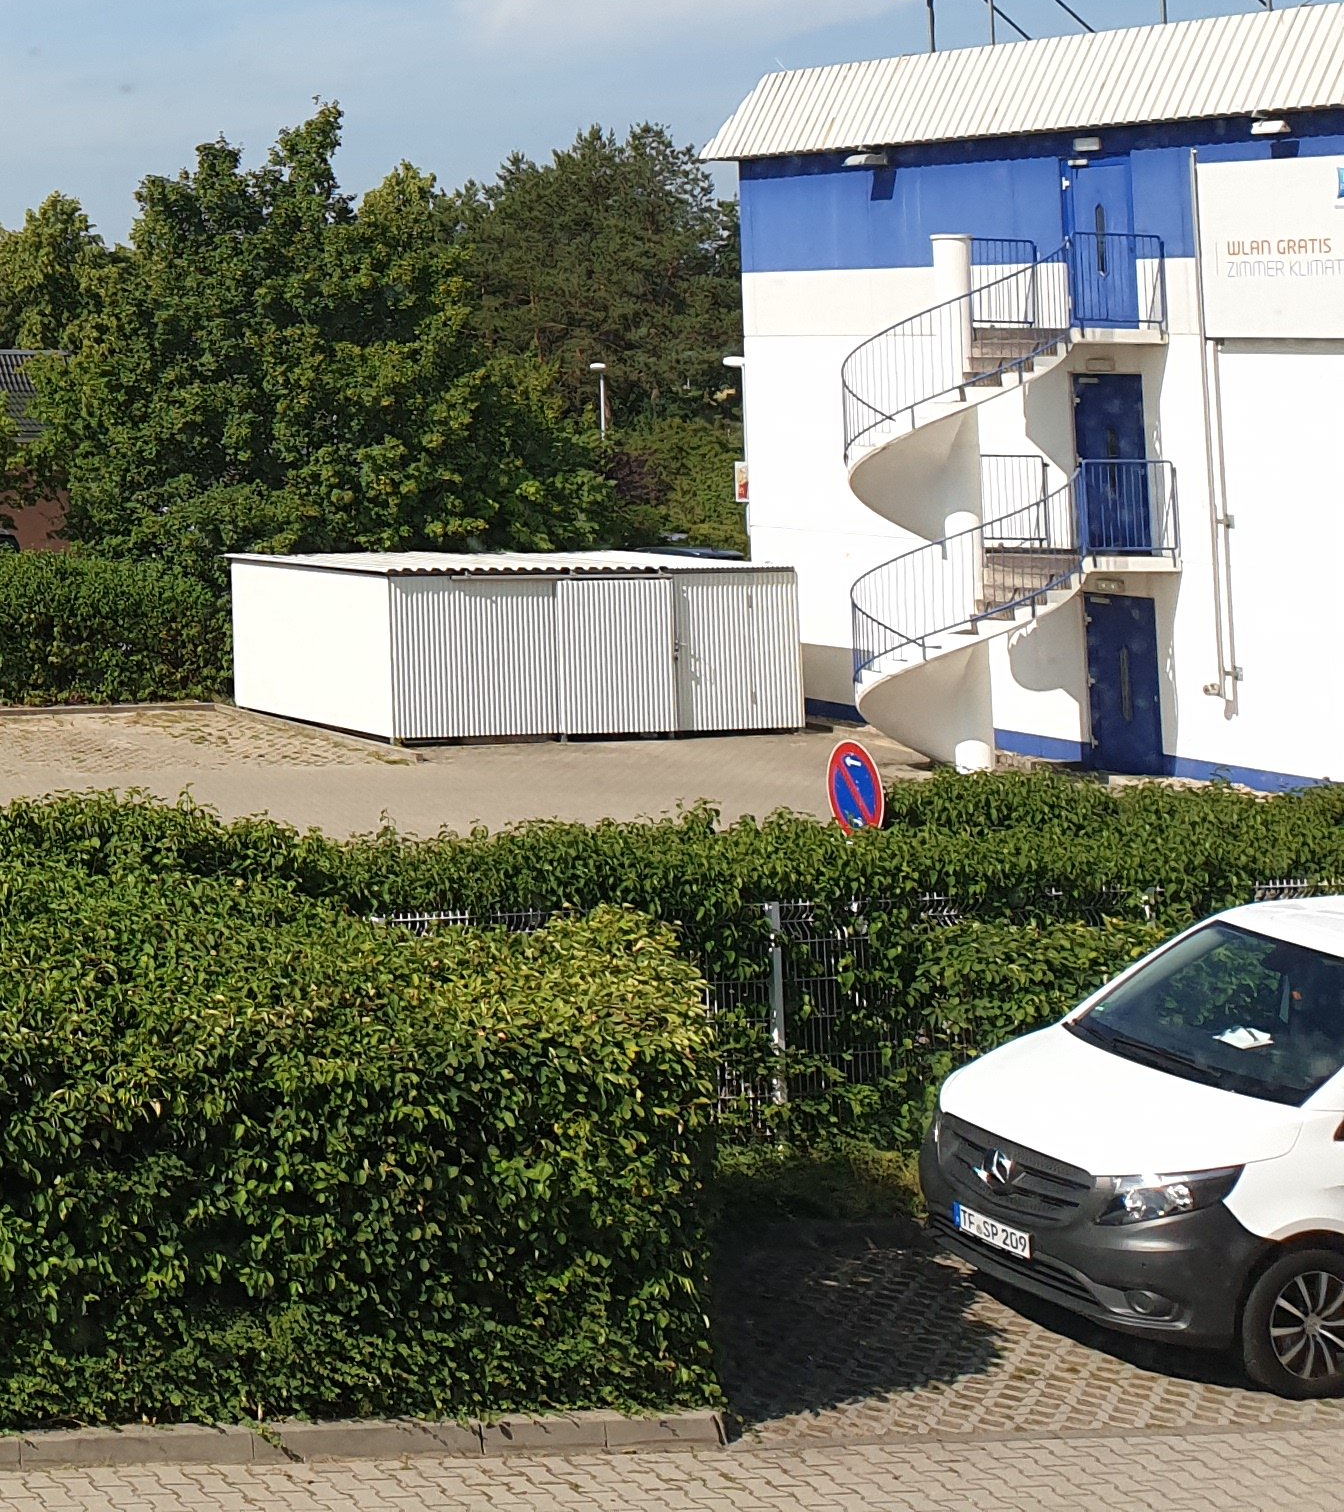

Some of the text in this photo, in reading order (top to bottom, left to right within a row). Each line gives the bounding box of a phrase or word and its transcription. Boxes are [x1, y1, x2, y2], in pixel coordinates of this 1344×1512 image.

[1227, 238, 1332, 256] WLAN GRATIS
[1227, 260, 1286, 278] ZIMMER
[960, 1208, 1028, 1253] TF SP 209
